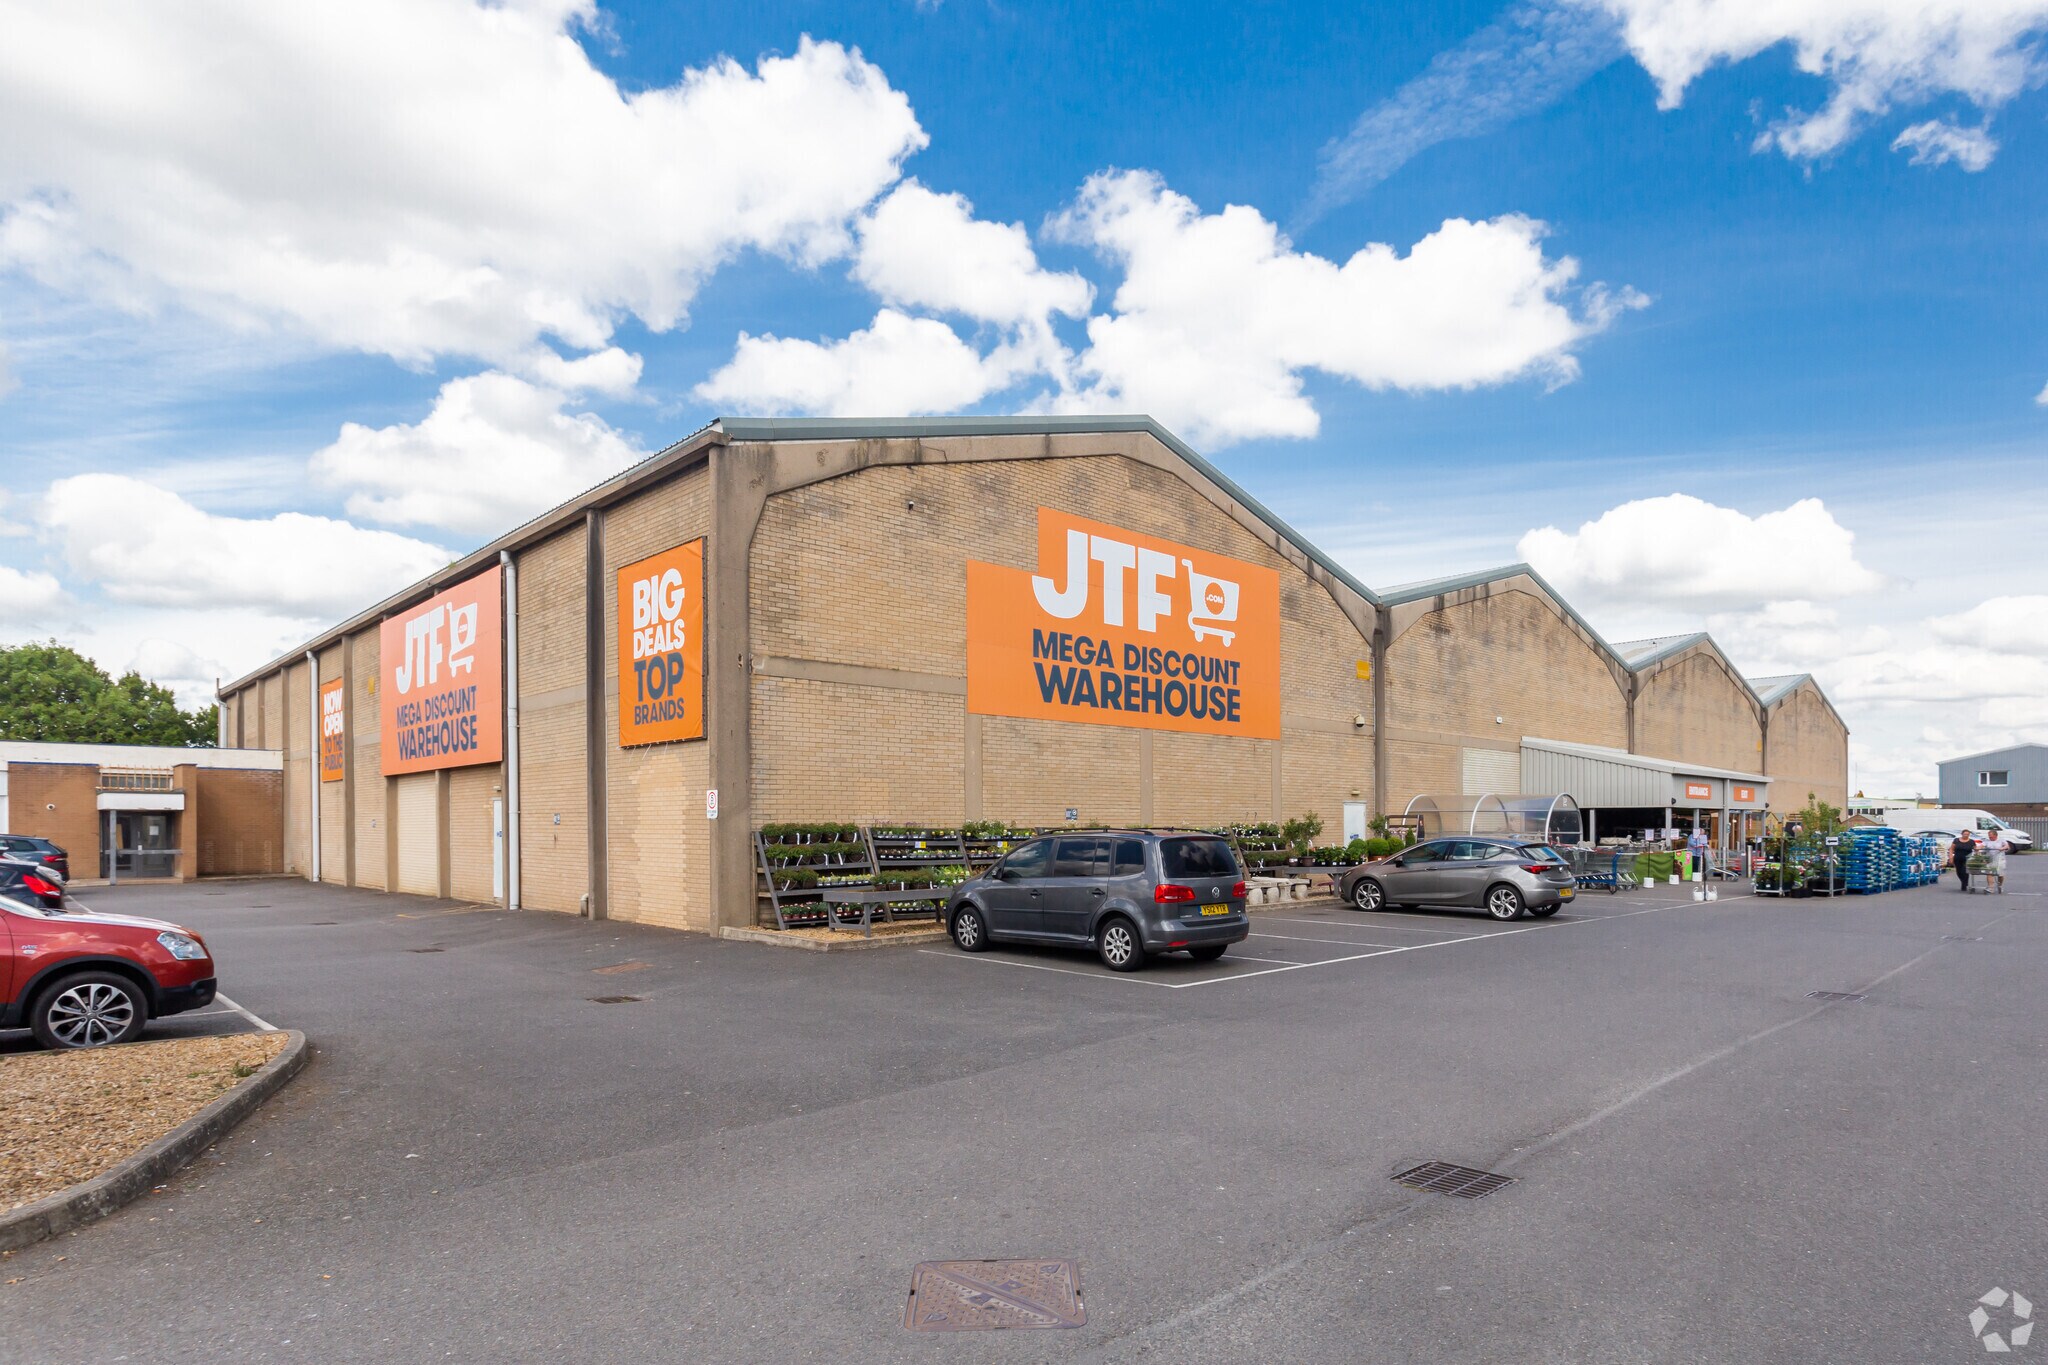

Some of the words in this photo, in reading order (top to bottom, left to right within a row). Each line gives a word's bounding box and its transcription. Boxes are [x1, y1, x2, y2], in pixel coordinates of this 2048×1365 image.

[633, 568, 685, 630] BIG
[1031, 529, 1176, 633] JTF
[1206, 594, 1223, 604] .COM
[395, 604, 445, 695] JTF
[633, 618, 685, 660] DEALS
[1032, 628, 1114, 669] MEGA
[1124, 643, 1241, 686] DISCOUNT
[634, 652, 684, 702] TOP
[1033, 662, 1241, 723] WAREHOUSE
[324, 688, 343, 715] NOW
[324, 711, 344, 737] OPEN
[397, 702, 422, 729] MEGA
[425, 685, 477, 722] DISCOUNT
[634, 697, 684, 726] BRANDS
[325, 738, 331, 754] TO
[397, 714, 478, 761] WAREHOUSE
